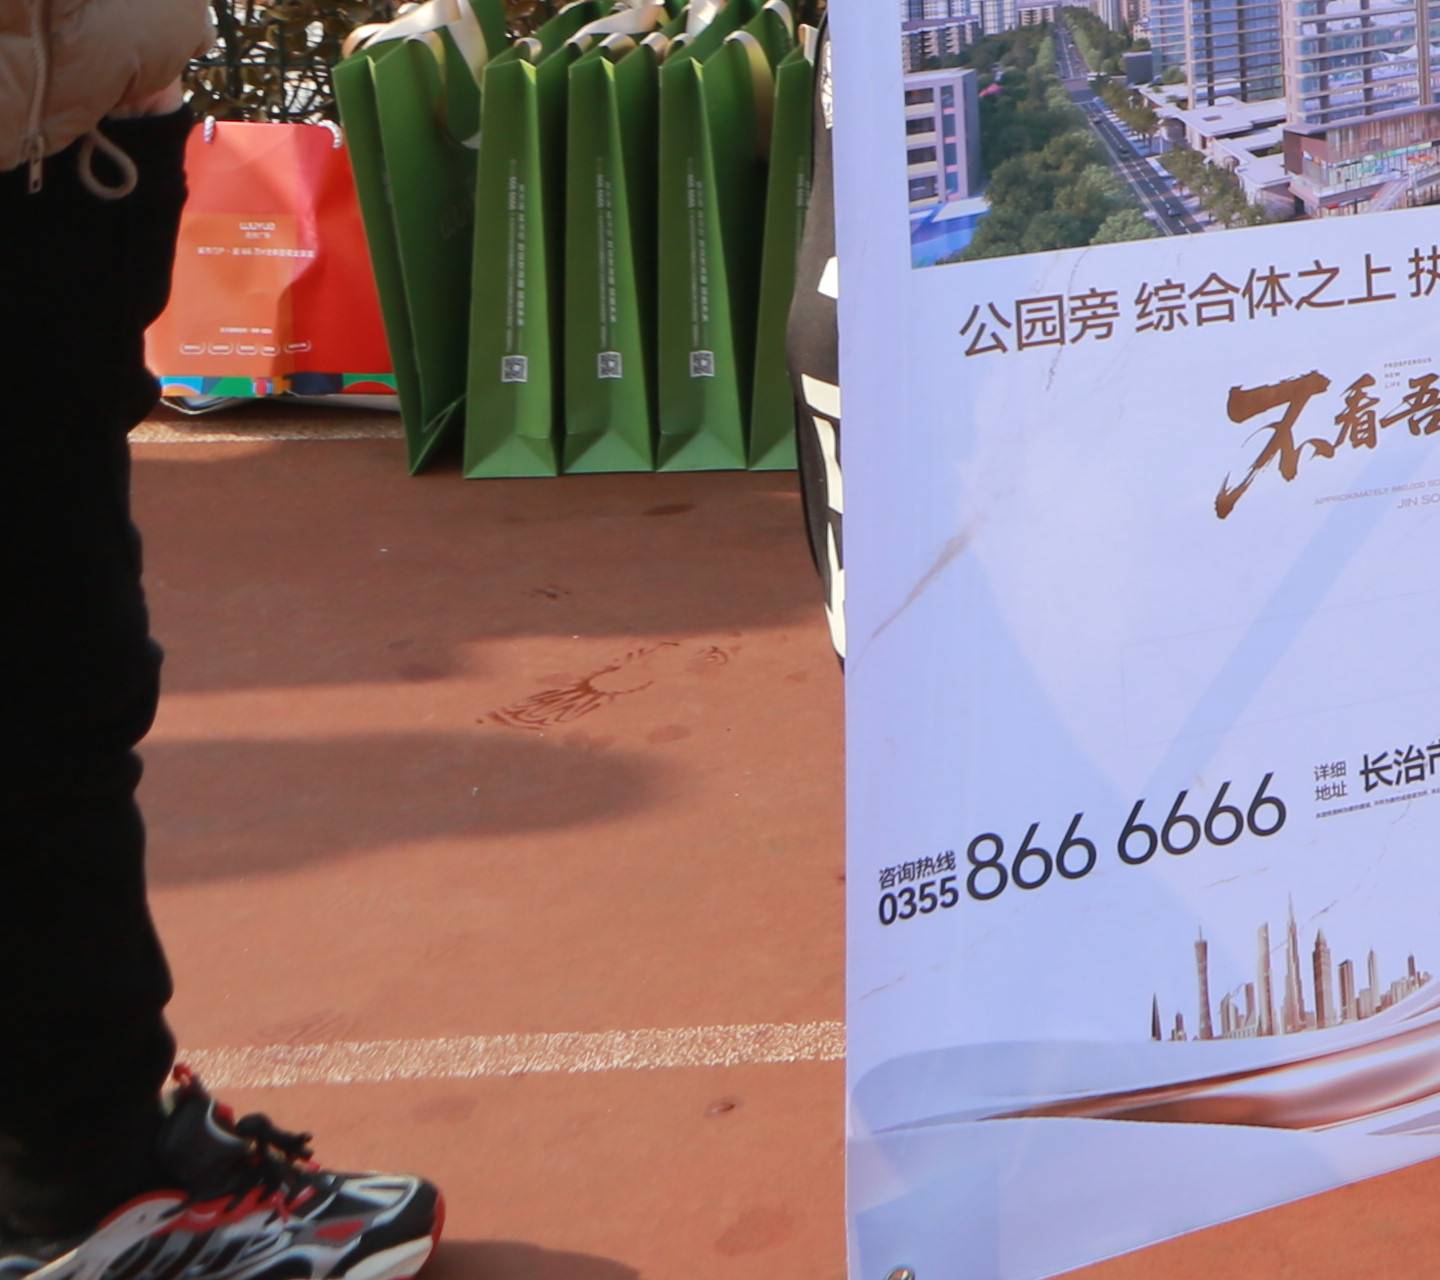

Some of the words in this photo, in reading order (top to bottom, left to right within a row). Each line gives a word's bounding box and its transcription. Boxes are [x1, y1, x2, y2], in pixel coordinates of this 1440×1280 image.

[957, 284, 1123, 361] 公园旁
[1133, 258, 1397, 336] 综合体之上
[1397, 496, 1419, 510] JIN
[1313, 760, 1347, 782] 详细
[1315, 780, 1348, 802] 地址
[965, 812, 1098, 902] 866
[1116, 771, 1288, 866] 6666
[878, 849, 957, 891] 咨询热线
[878, 876, 960, 927] 0355
